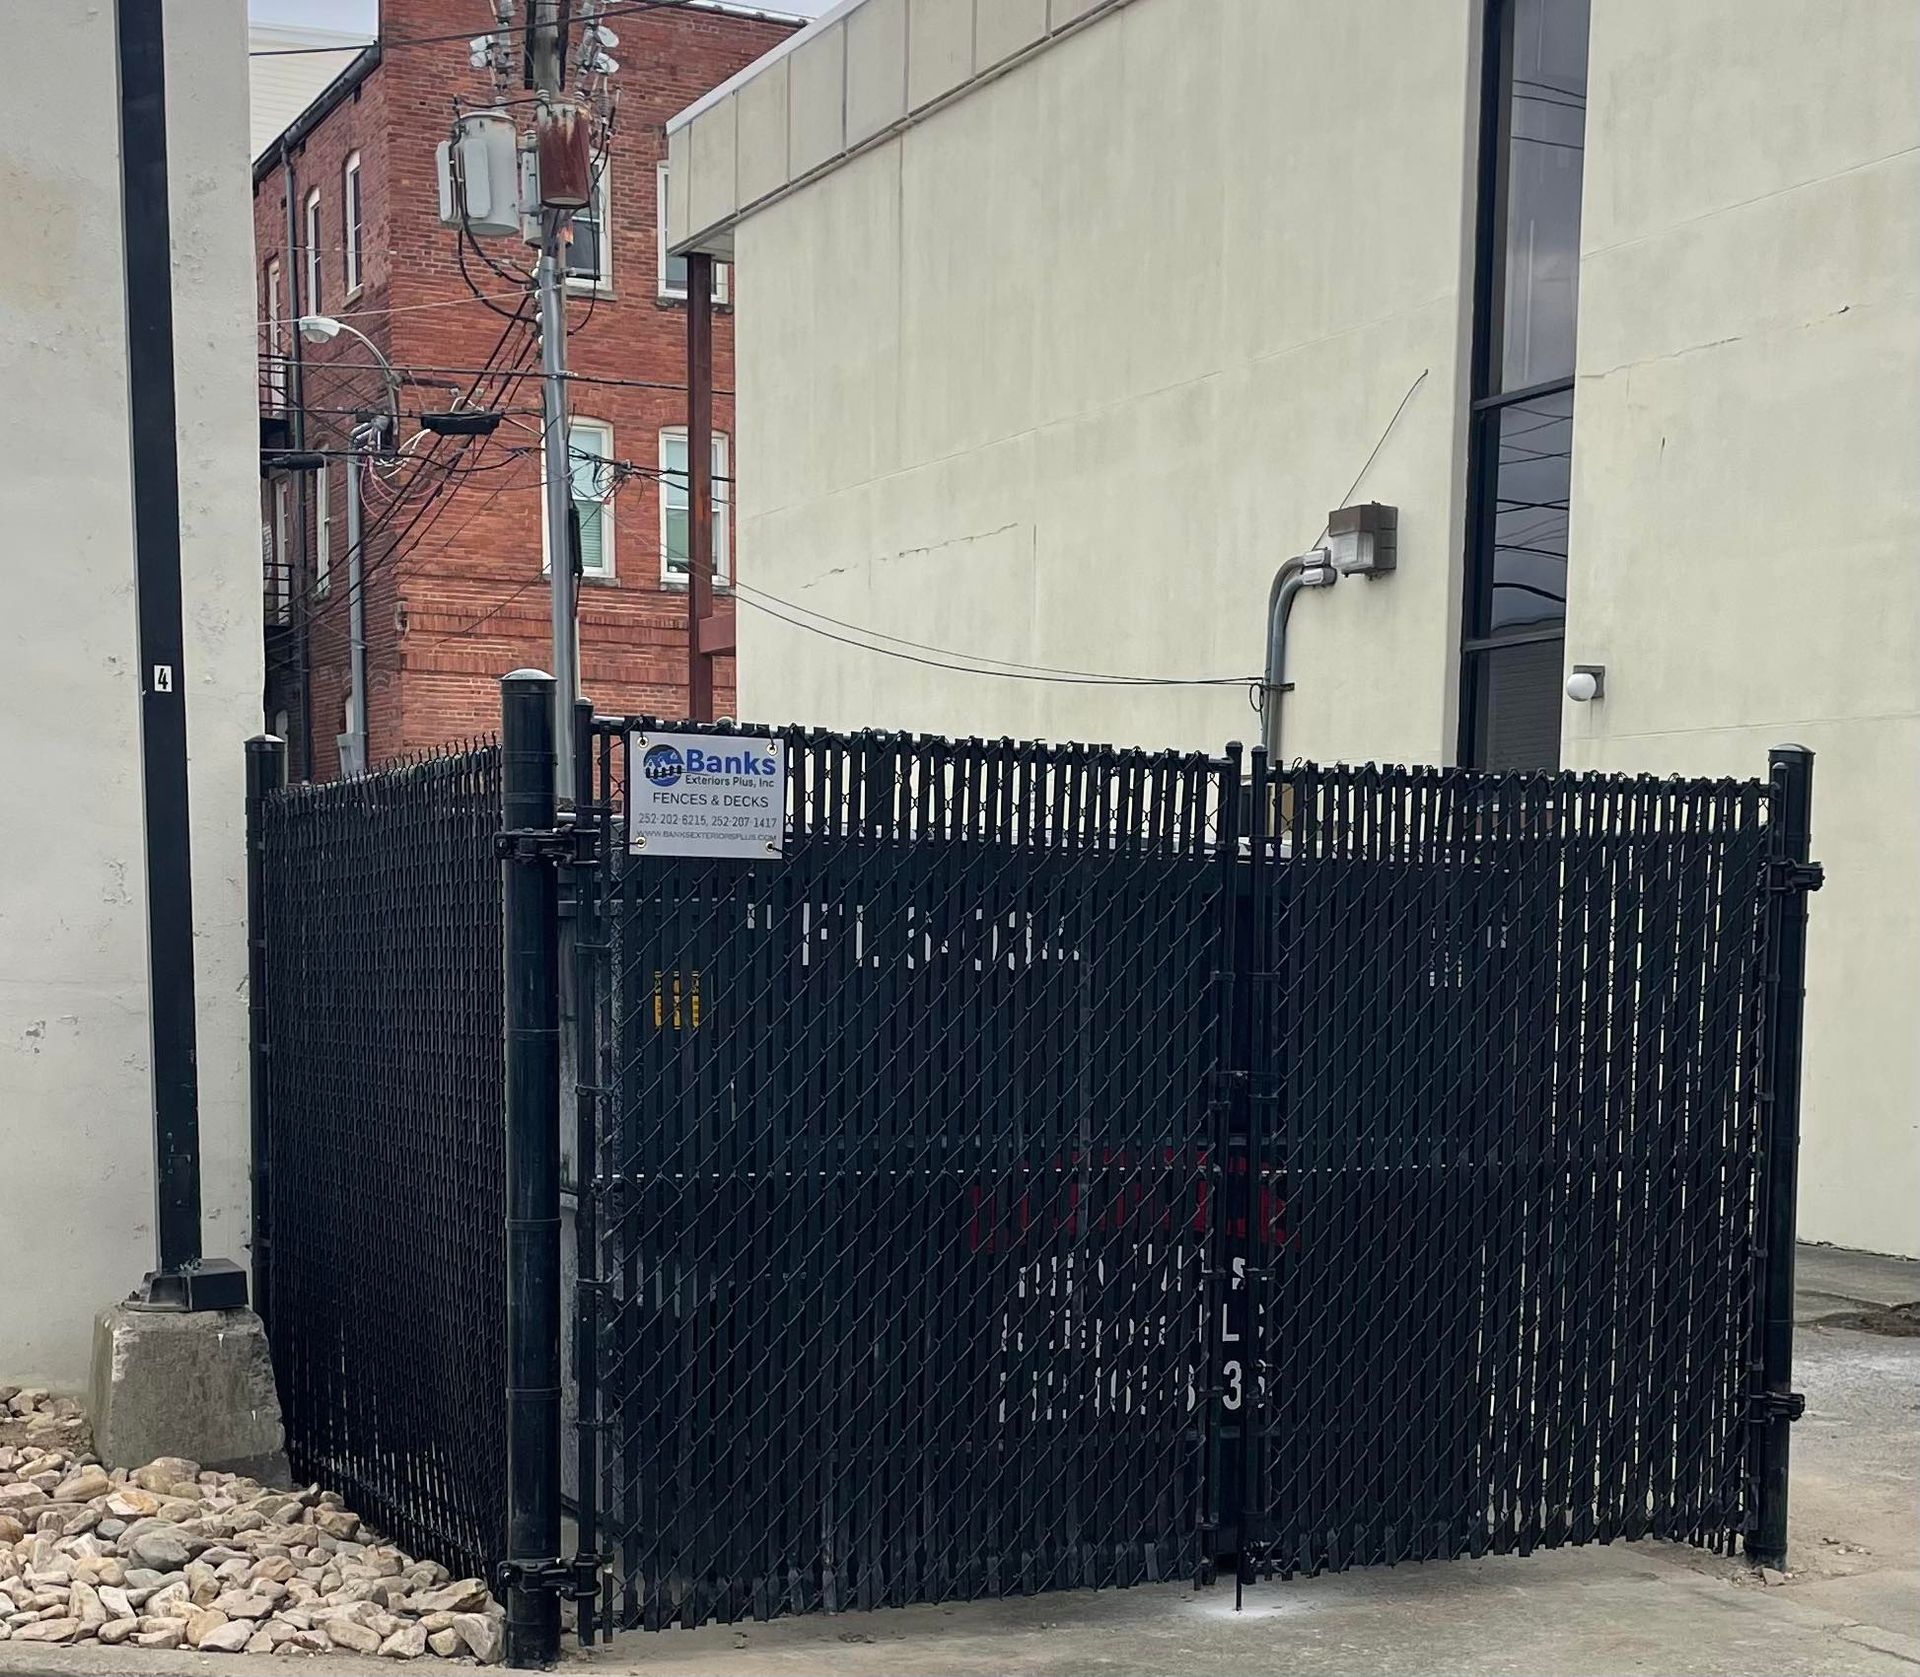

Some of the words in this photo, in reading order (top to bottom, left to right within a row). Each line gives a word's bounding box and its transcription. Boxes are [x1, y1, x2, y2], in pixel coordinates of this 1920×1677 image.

[158, 668, 168, 690] 4
[686, 749, 776, 776] Banks
[685, 775, 730, 787] Exteriors
[733, 777, 756, 788] Plus,
[759, 779, 774, 788] Inc
[653, 792, 707, 806] FENCES
[711, 795, 720, 806] &
[723, 795, 769, 808] DECKS
